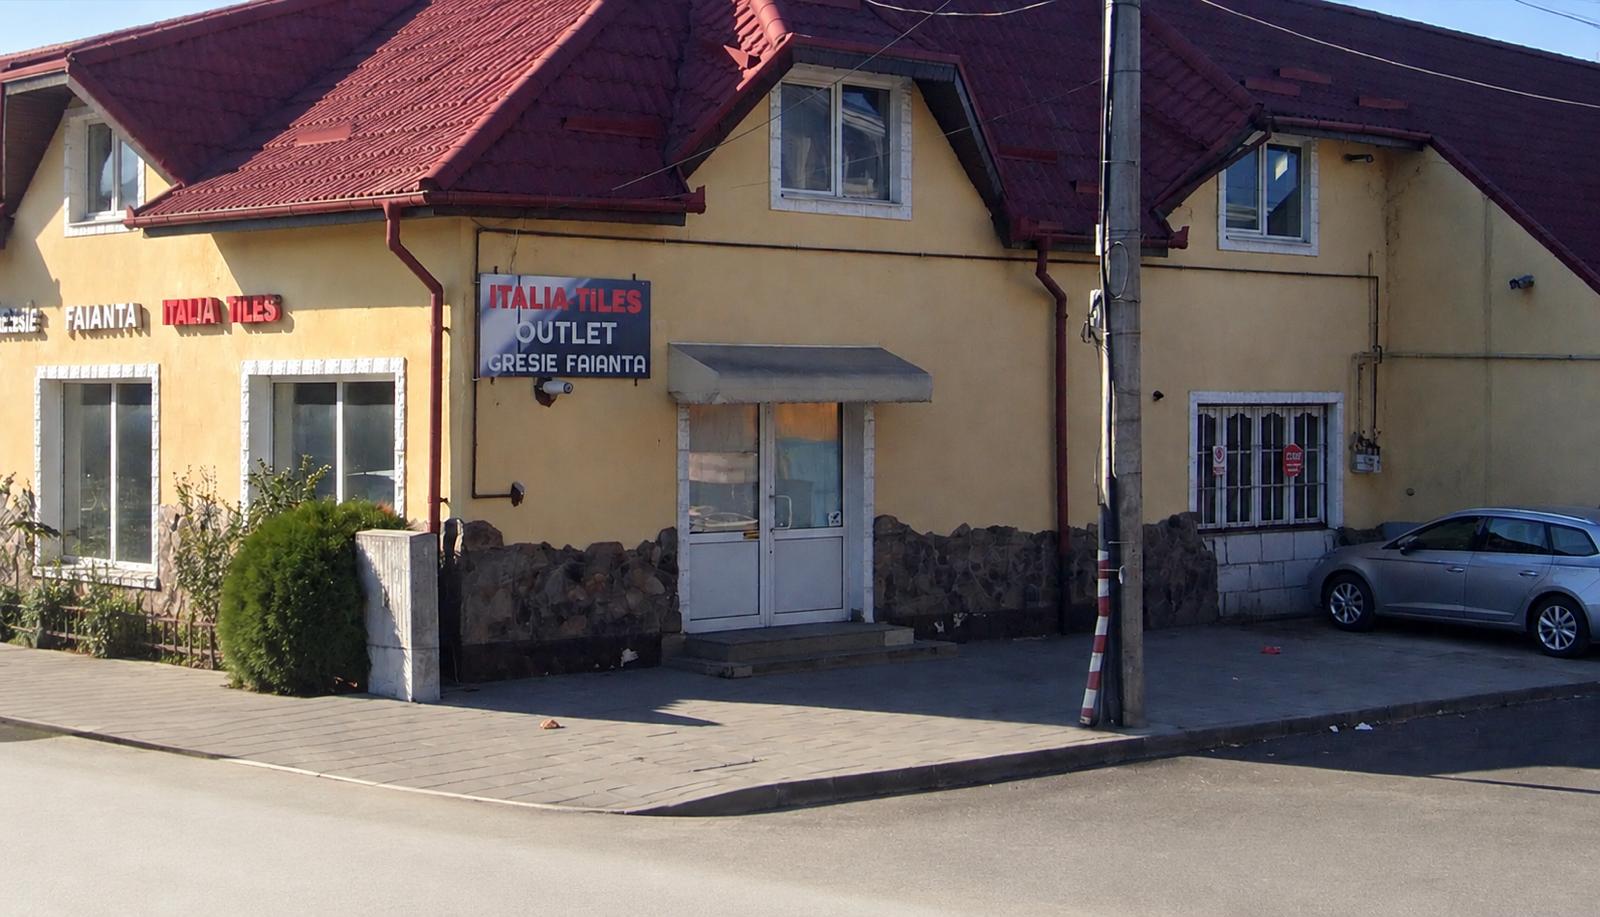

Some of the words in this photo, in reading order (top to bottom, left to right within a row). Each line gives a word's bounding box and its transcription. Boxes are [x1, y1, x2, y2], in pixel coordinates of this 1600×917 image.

[65, 303, 139, 330] FAIANTA
[162, 297, 221, 325] ITALIA
[515, 320, 617, 345] OUTLET
[488, 353, 558, 373] GRESIE
[566, 354, 646, 374] FAIANTA
